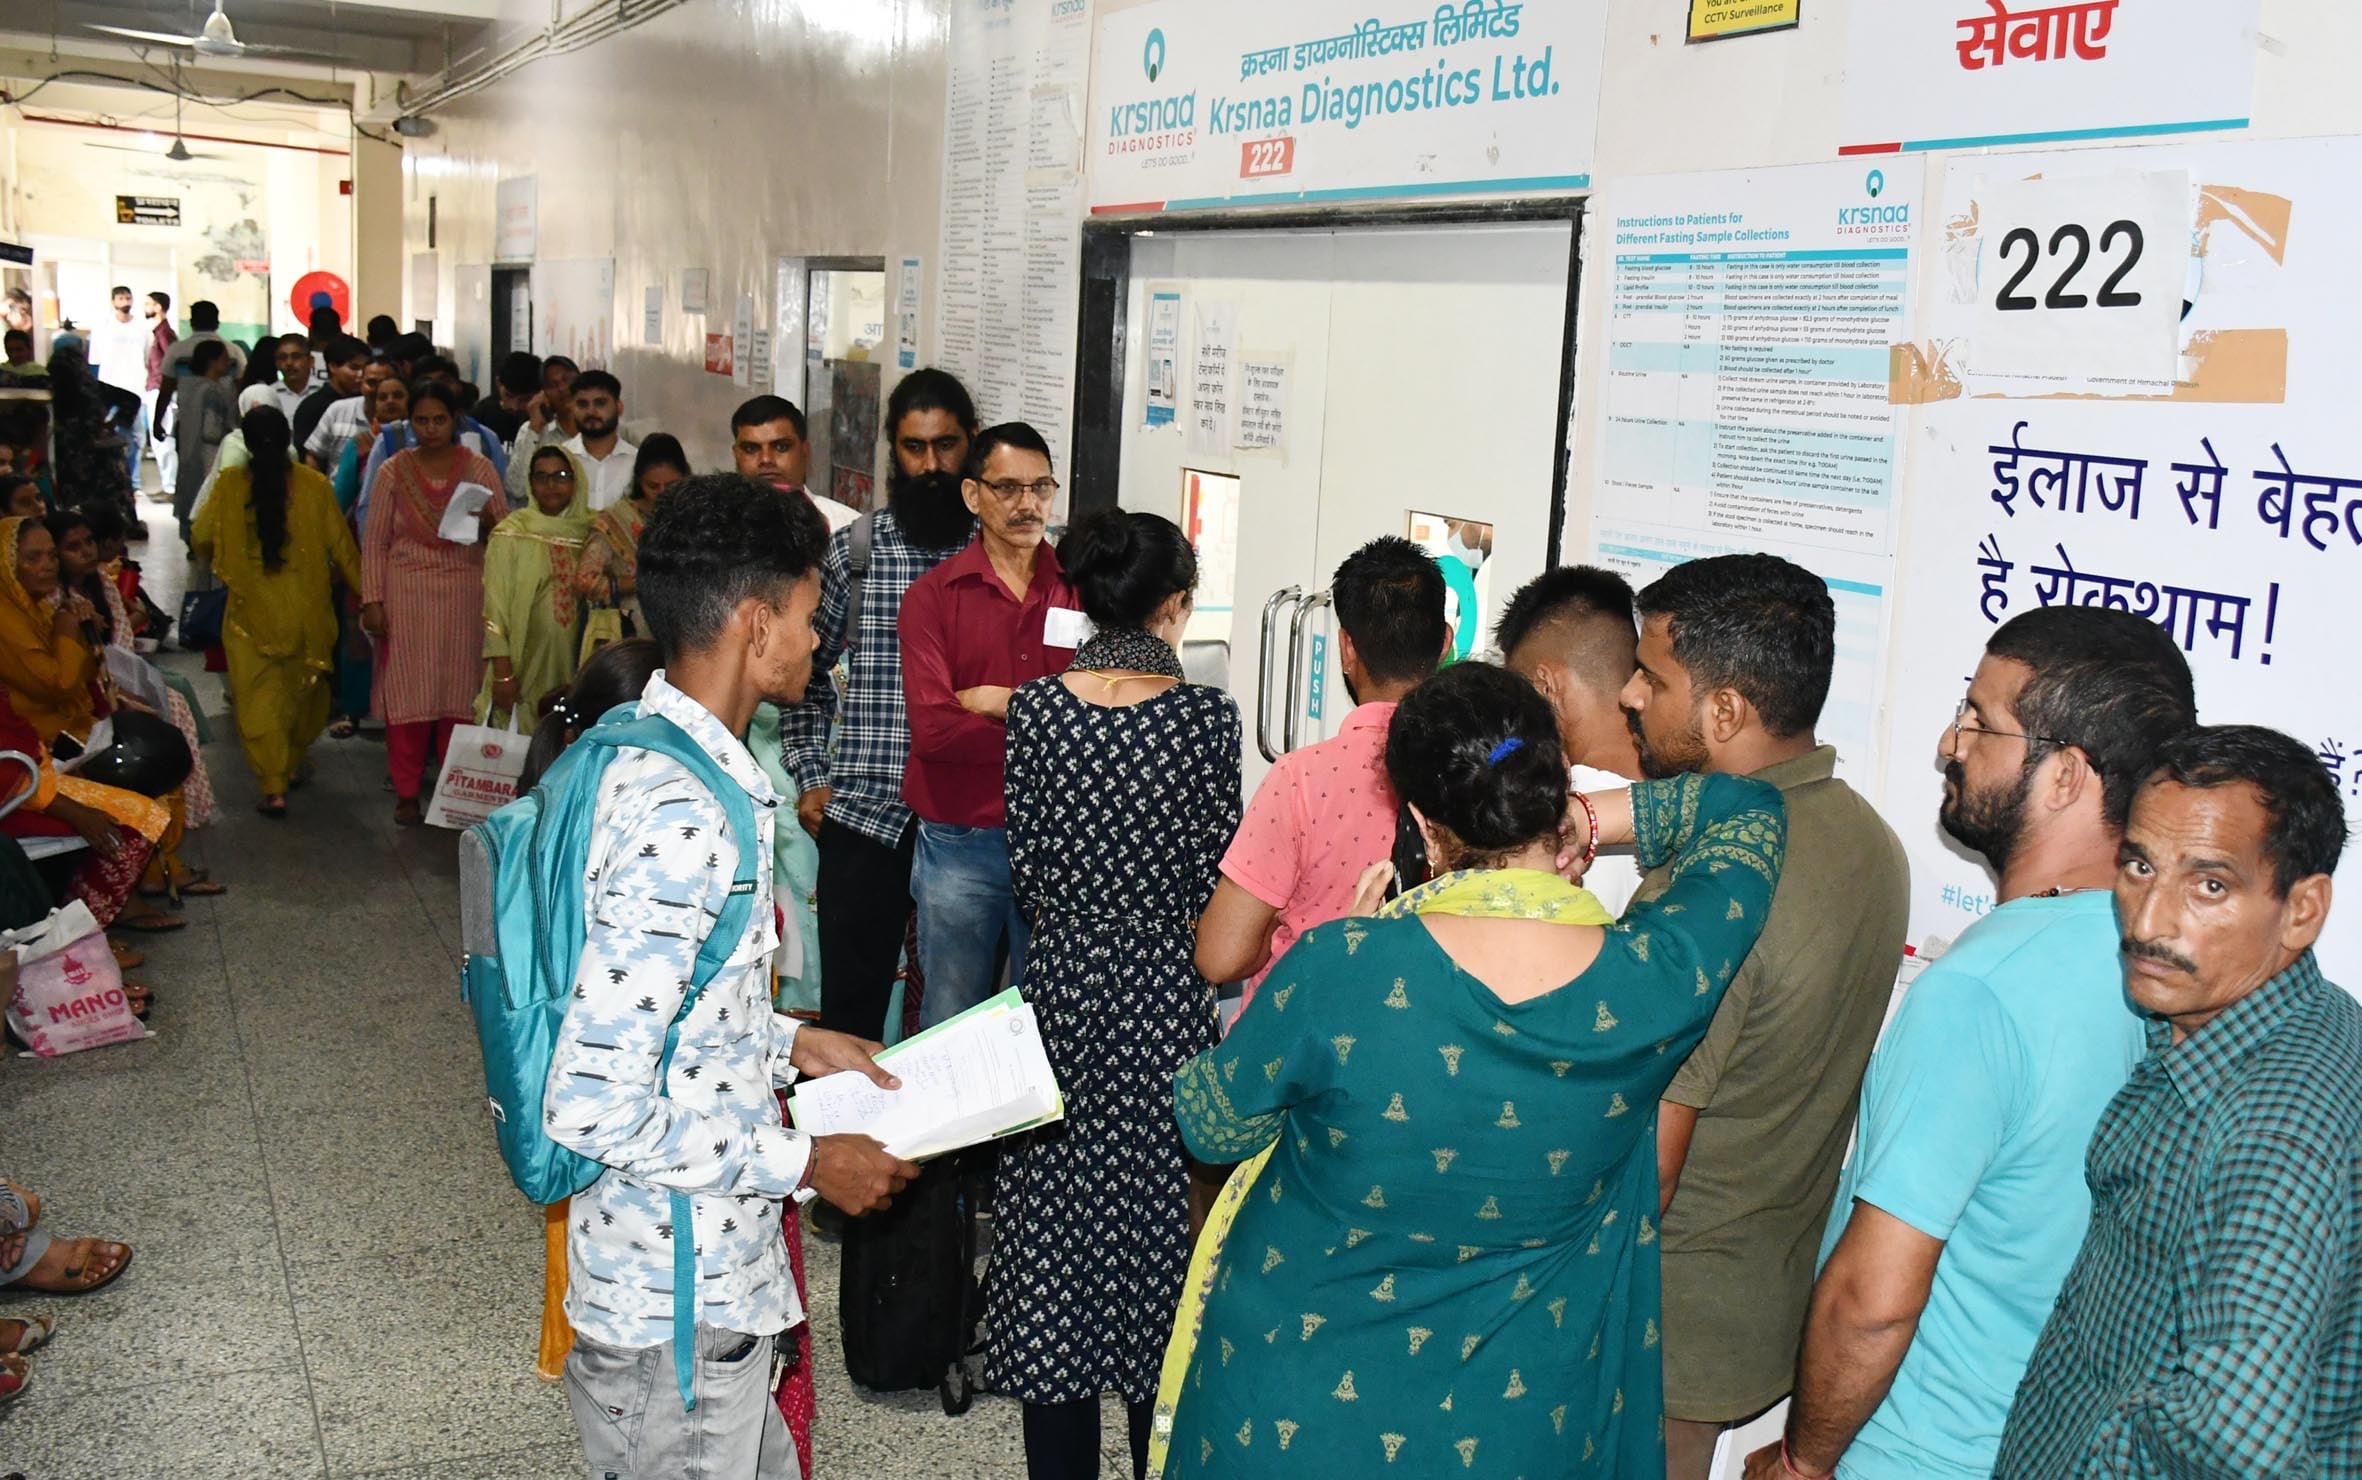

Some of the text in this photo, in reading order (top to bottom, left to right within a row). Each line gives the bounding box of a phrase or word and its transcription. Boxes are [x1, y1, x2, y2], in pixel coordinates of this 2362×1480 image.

[1704, 3, 1784, 24] CCTV Surveillance
[1240, 0, 1524, 82] क्रस्ना डायग्नोस्टिक्स लिमिटेड
[1209, 46, 1560, 134] Krsnaa Diagnostics Ltd.
[1109, 132, 1193, 154] DIAGNOSTICS
[1250, 141, 1285, 173] 222
[1616, 229, 1789, 245] Different Fasting Sample Collections
[1617, 212, 1743, 228] Instructions to Patients for
[1837, 225, 1908, 235] DIAGNOSTICS
[1996, 220, 2144, 310] 222
[1988, 420, 2148, 520] ईलाज
[2170, 436, 2228, 530] से
[1978, 533, 2014, 624] है
[1312, 641, 1322, 712] PUSH
[48, 989, 123, 1024] MANO
